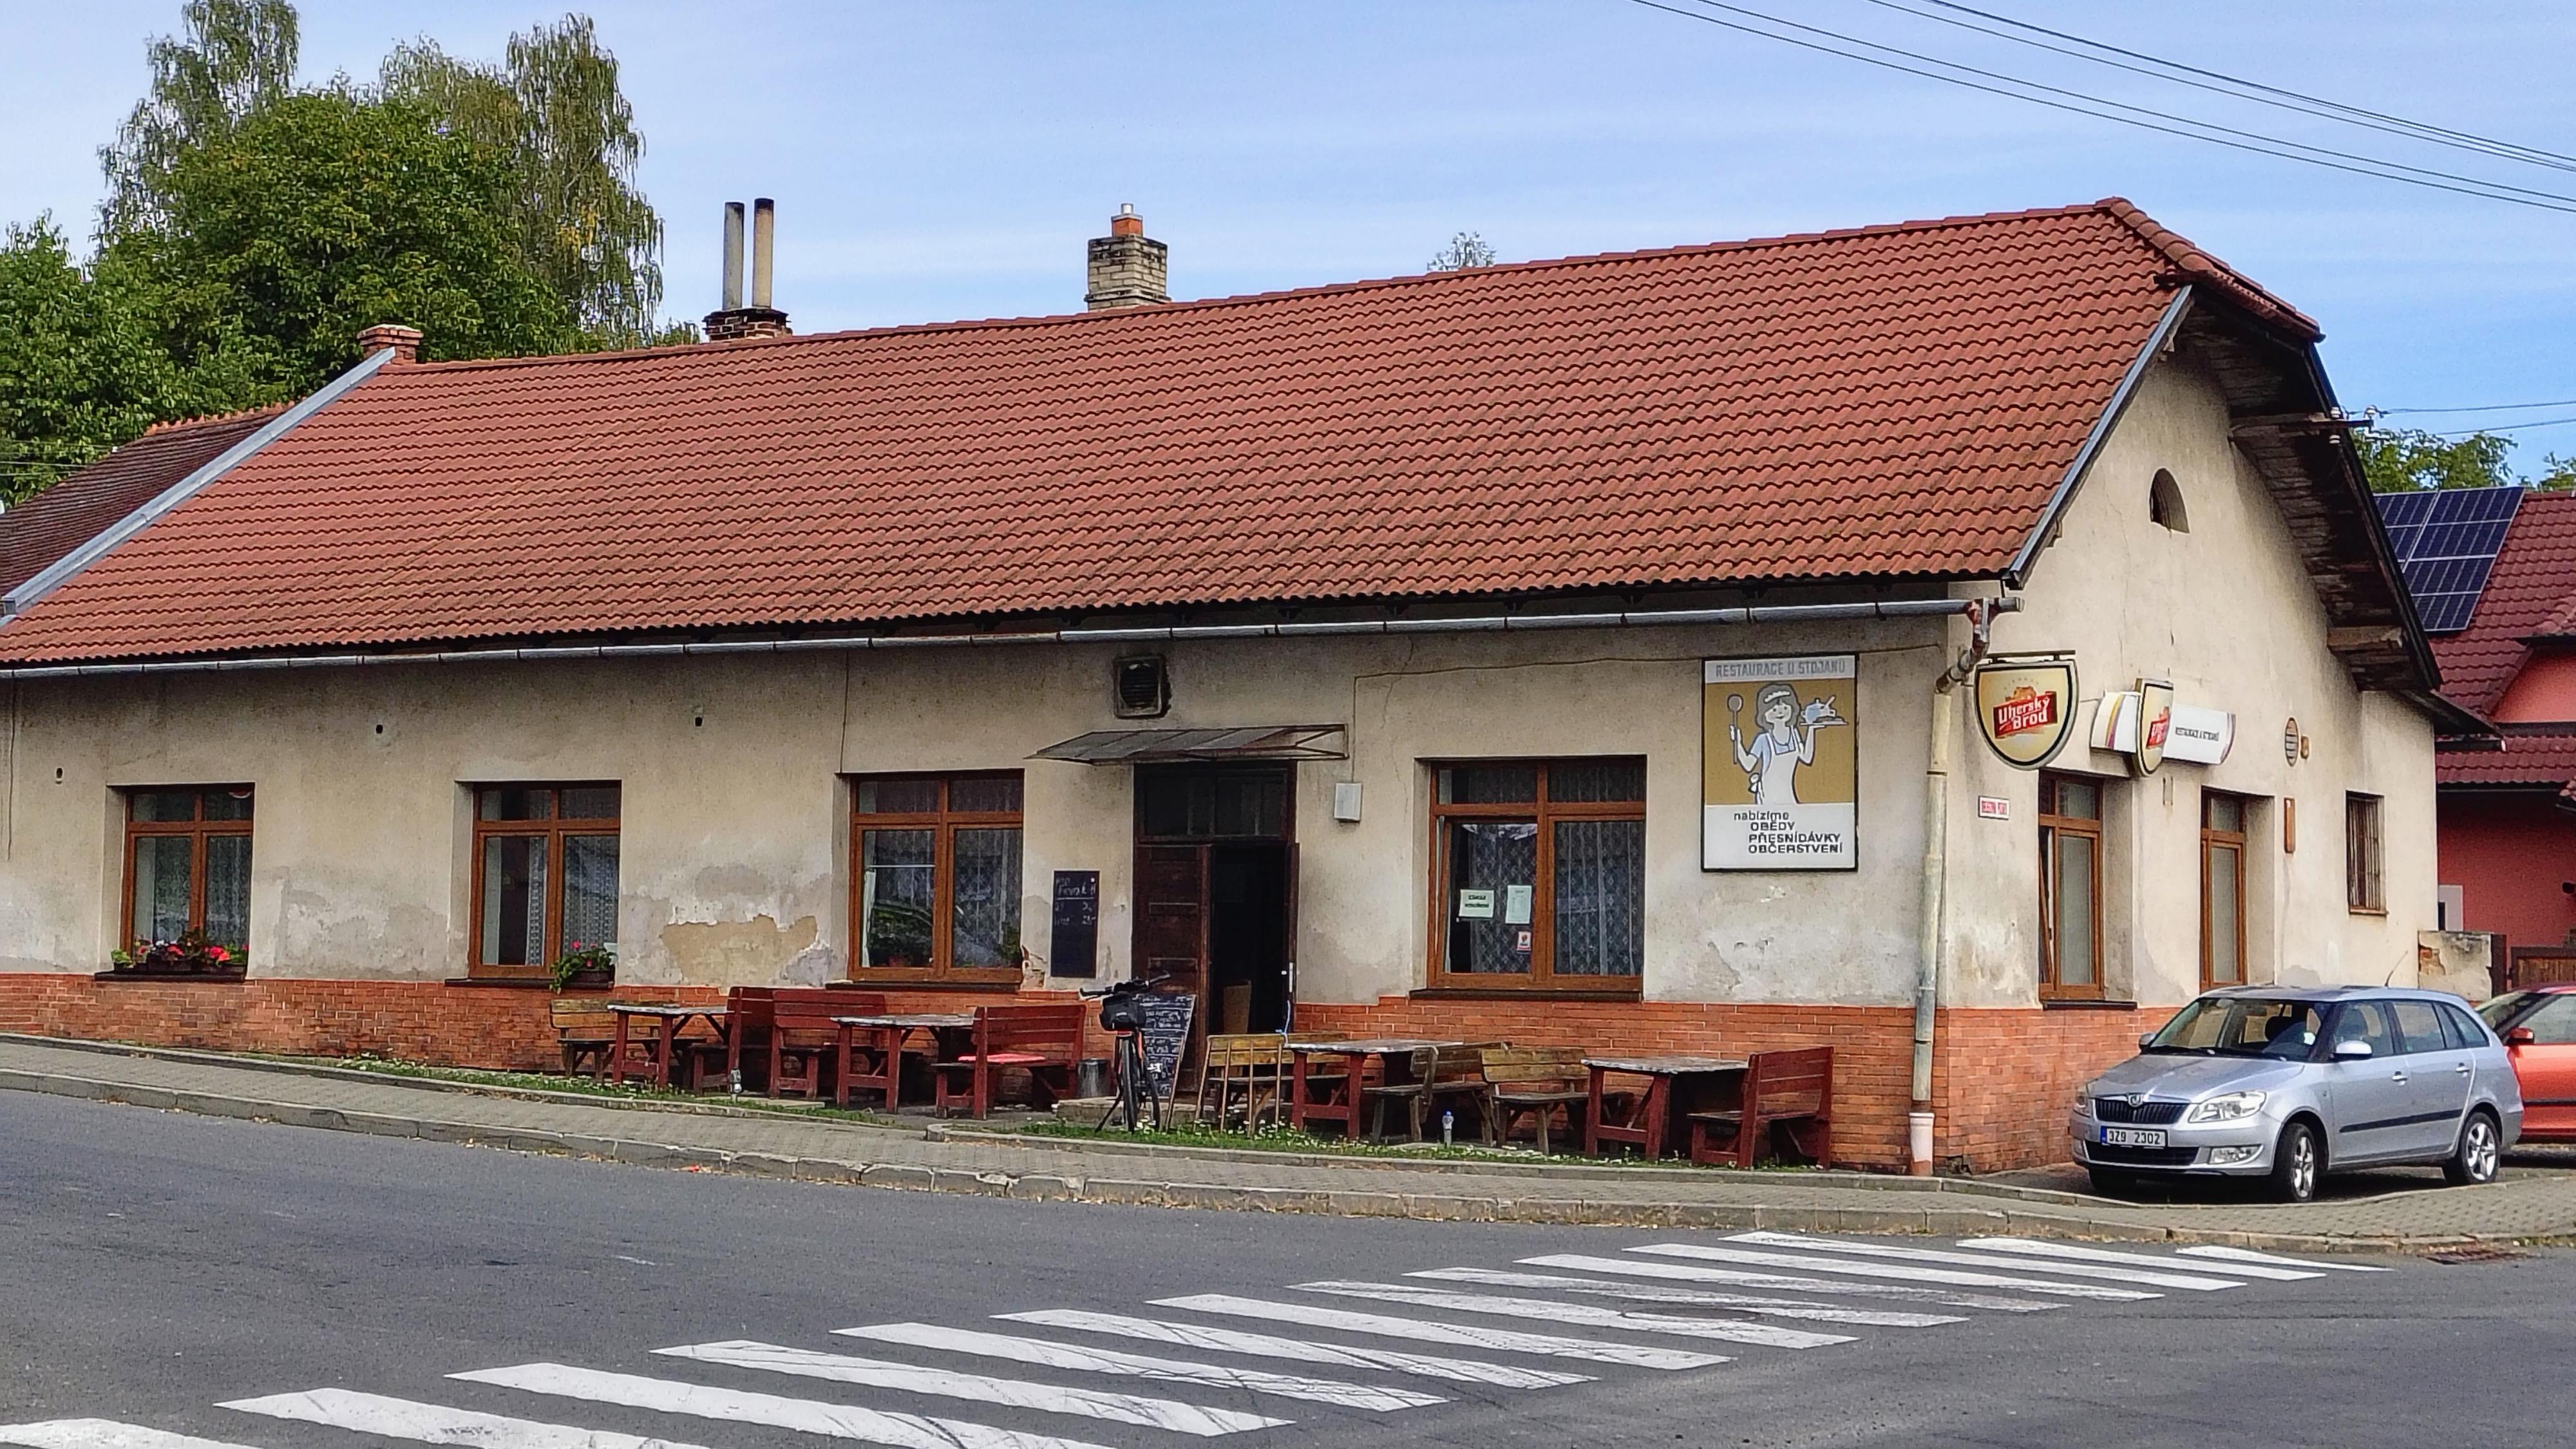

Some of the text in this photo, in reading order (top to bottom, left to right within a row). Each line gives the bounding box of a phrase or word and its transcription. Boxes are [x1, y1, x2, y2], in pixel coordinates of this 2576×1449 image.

[1716, 663, 1783, 676] RESTAURACE
[1787, 662, 1794, 675] U
[1998, 697, 2050, 724] Uherský
[2011, 708, 2048, 730] Brod
[1748, 831, 1841, 843] PŘESNÍDÁVKY
[1748, 842, 1842, 853] OBČERSTVENÍ
[2134, 1132, 2161, 1144] 2302
